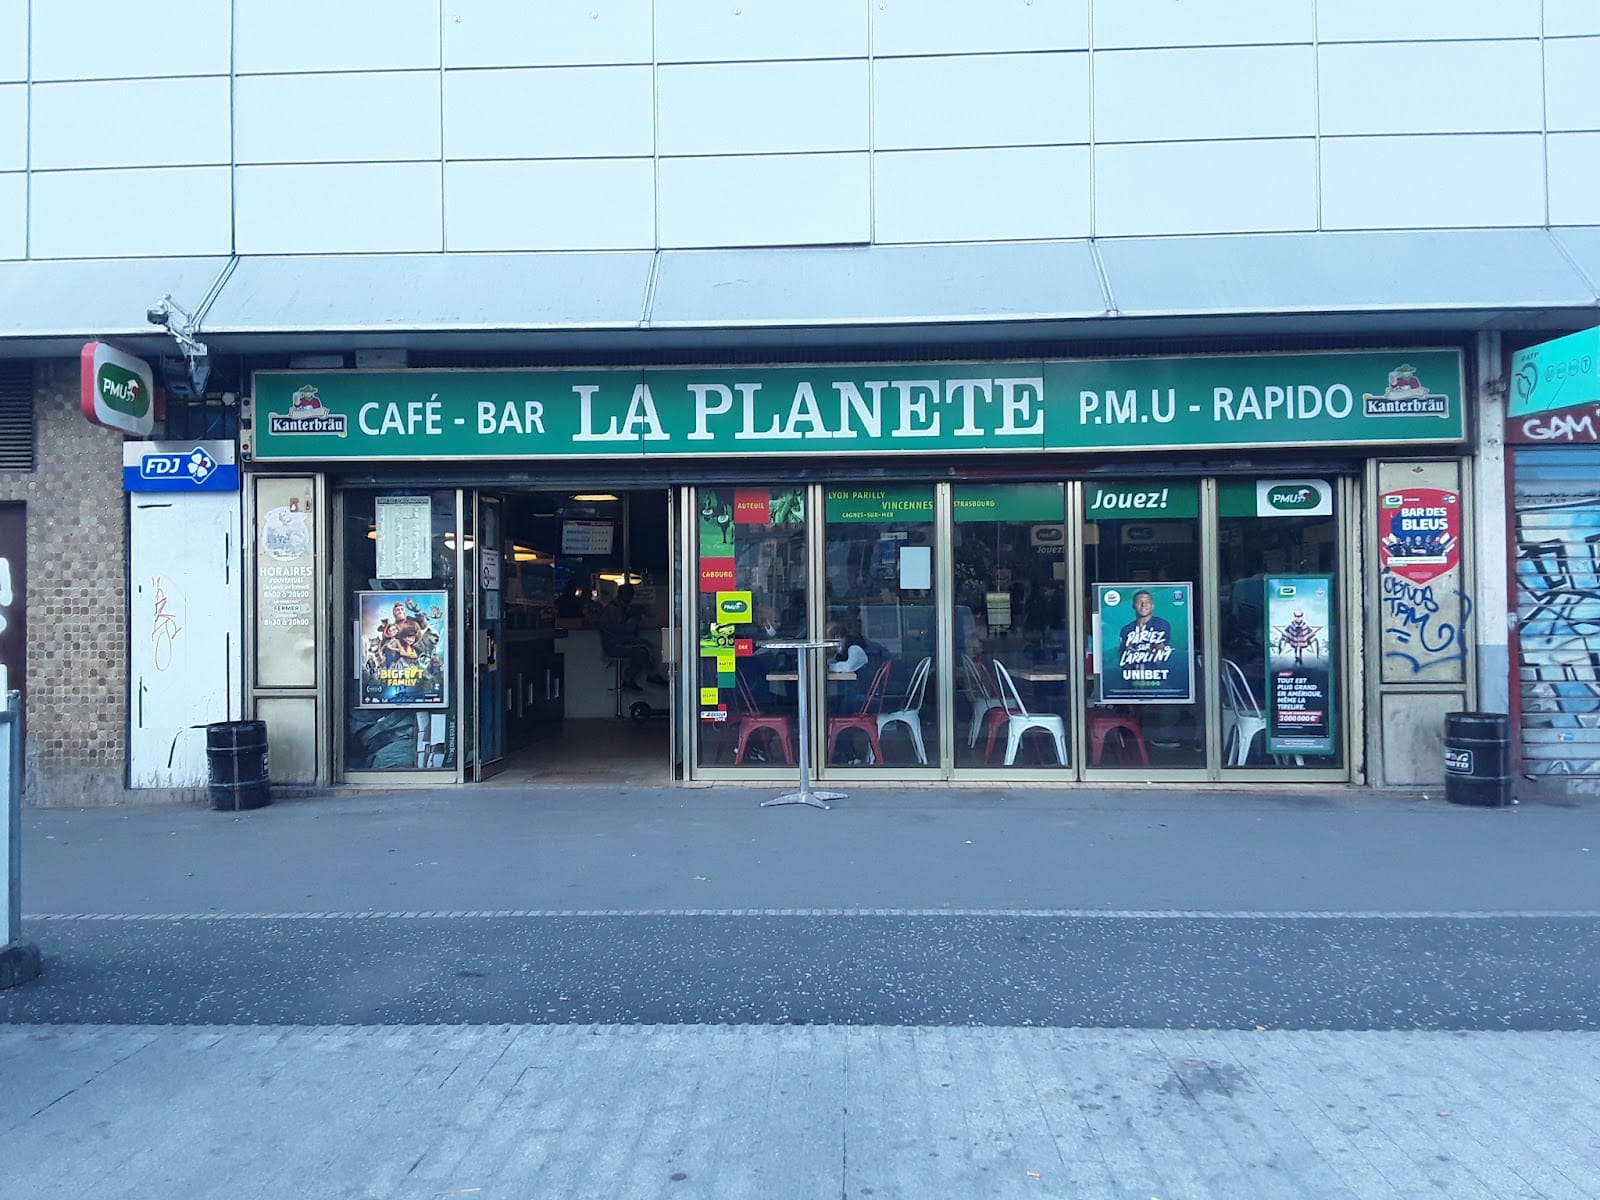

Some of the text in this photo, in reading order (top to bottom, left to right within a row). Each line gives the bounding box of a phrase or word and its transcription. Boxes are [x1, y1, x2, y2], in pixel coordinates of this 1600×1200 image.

[103, 378, 128, 399] PMU
[358, 393, 442, 436] CAFÉ
[477, 401, 546, 434] BAR
[571, 383, 670, 442] LA
[686, 377, 1045, 440] PLANETE
[1079, 388, 1176, 425] P.M.U
[1213, 383, 1353, 422] RAPIDO
[1367, 399, 1445, 415] Kanterbräu
[273, 418, 343, 431] Kanterbräu
[145, 458, 181, 474] FDJ
[828, 491, 886, 500] LYON PARILLY
[1091, 488, 1169, 509] Jouez!
[1272, 494, 1298, 503] PMU
[737, 502, 765, 510] AUTEUIL
[881, 500, 933, 510] VINCENNES
[953, 499, 995, 508] STRASBOURG
[1401, 507, 1447, 517] BAR DES
[1401, 518, 1449, 531] BLEUS
[259, 566, 313, 577] HORAIRES
[288, 618, 310, 626] 20h00
[380, 666, 425, 679] BIGFOOT
[1122, 669, 1170, 680] UNIBET
[387, 679, 417, 687] FAMILY
